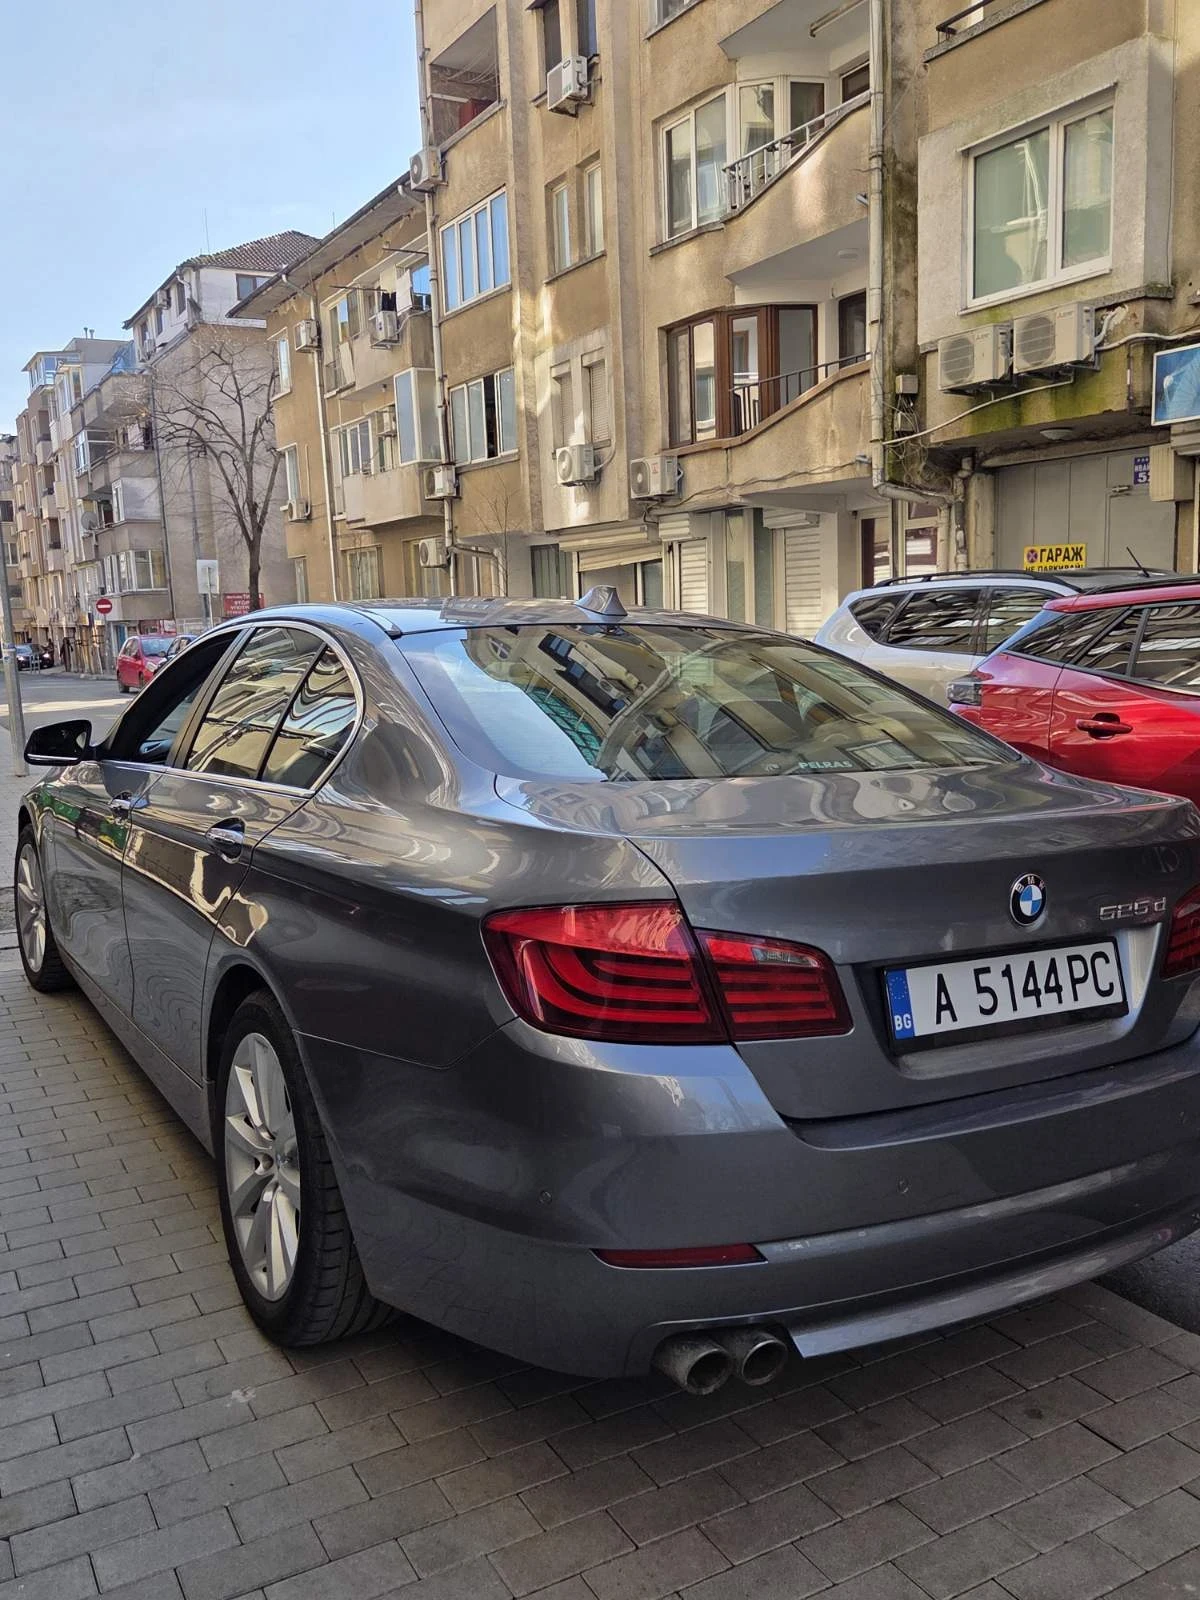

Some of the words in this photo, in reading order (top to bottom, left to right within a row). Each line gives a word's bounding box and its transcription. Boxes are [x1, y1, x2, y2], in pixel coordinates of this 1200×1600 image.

[1040, 547, 1083, 562] ГАРАЖ
[799, 761, 853, 769] PELRAS
[1015, 876, 1045, 893] BMW
[1099, 897, 1166, 920] 525d
[935, 973, 958, 1025] A
[973, 951, 1113, 1015] 5144PC
[894, 1014, 911, 1030] BG
